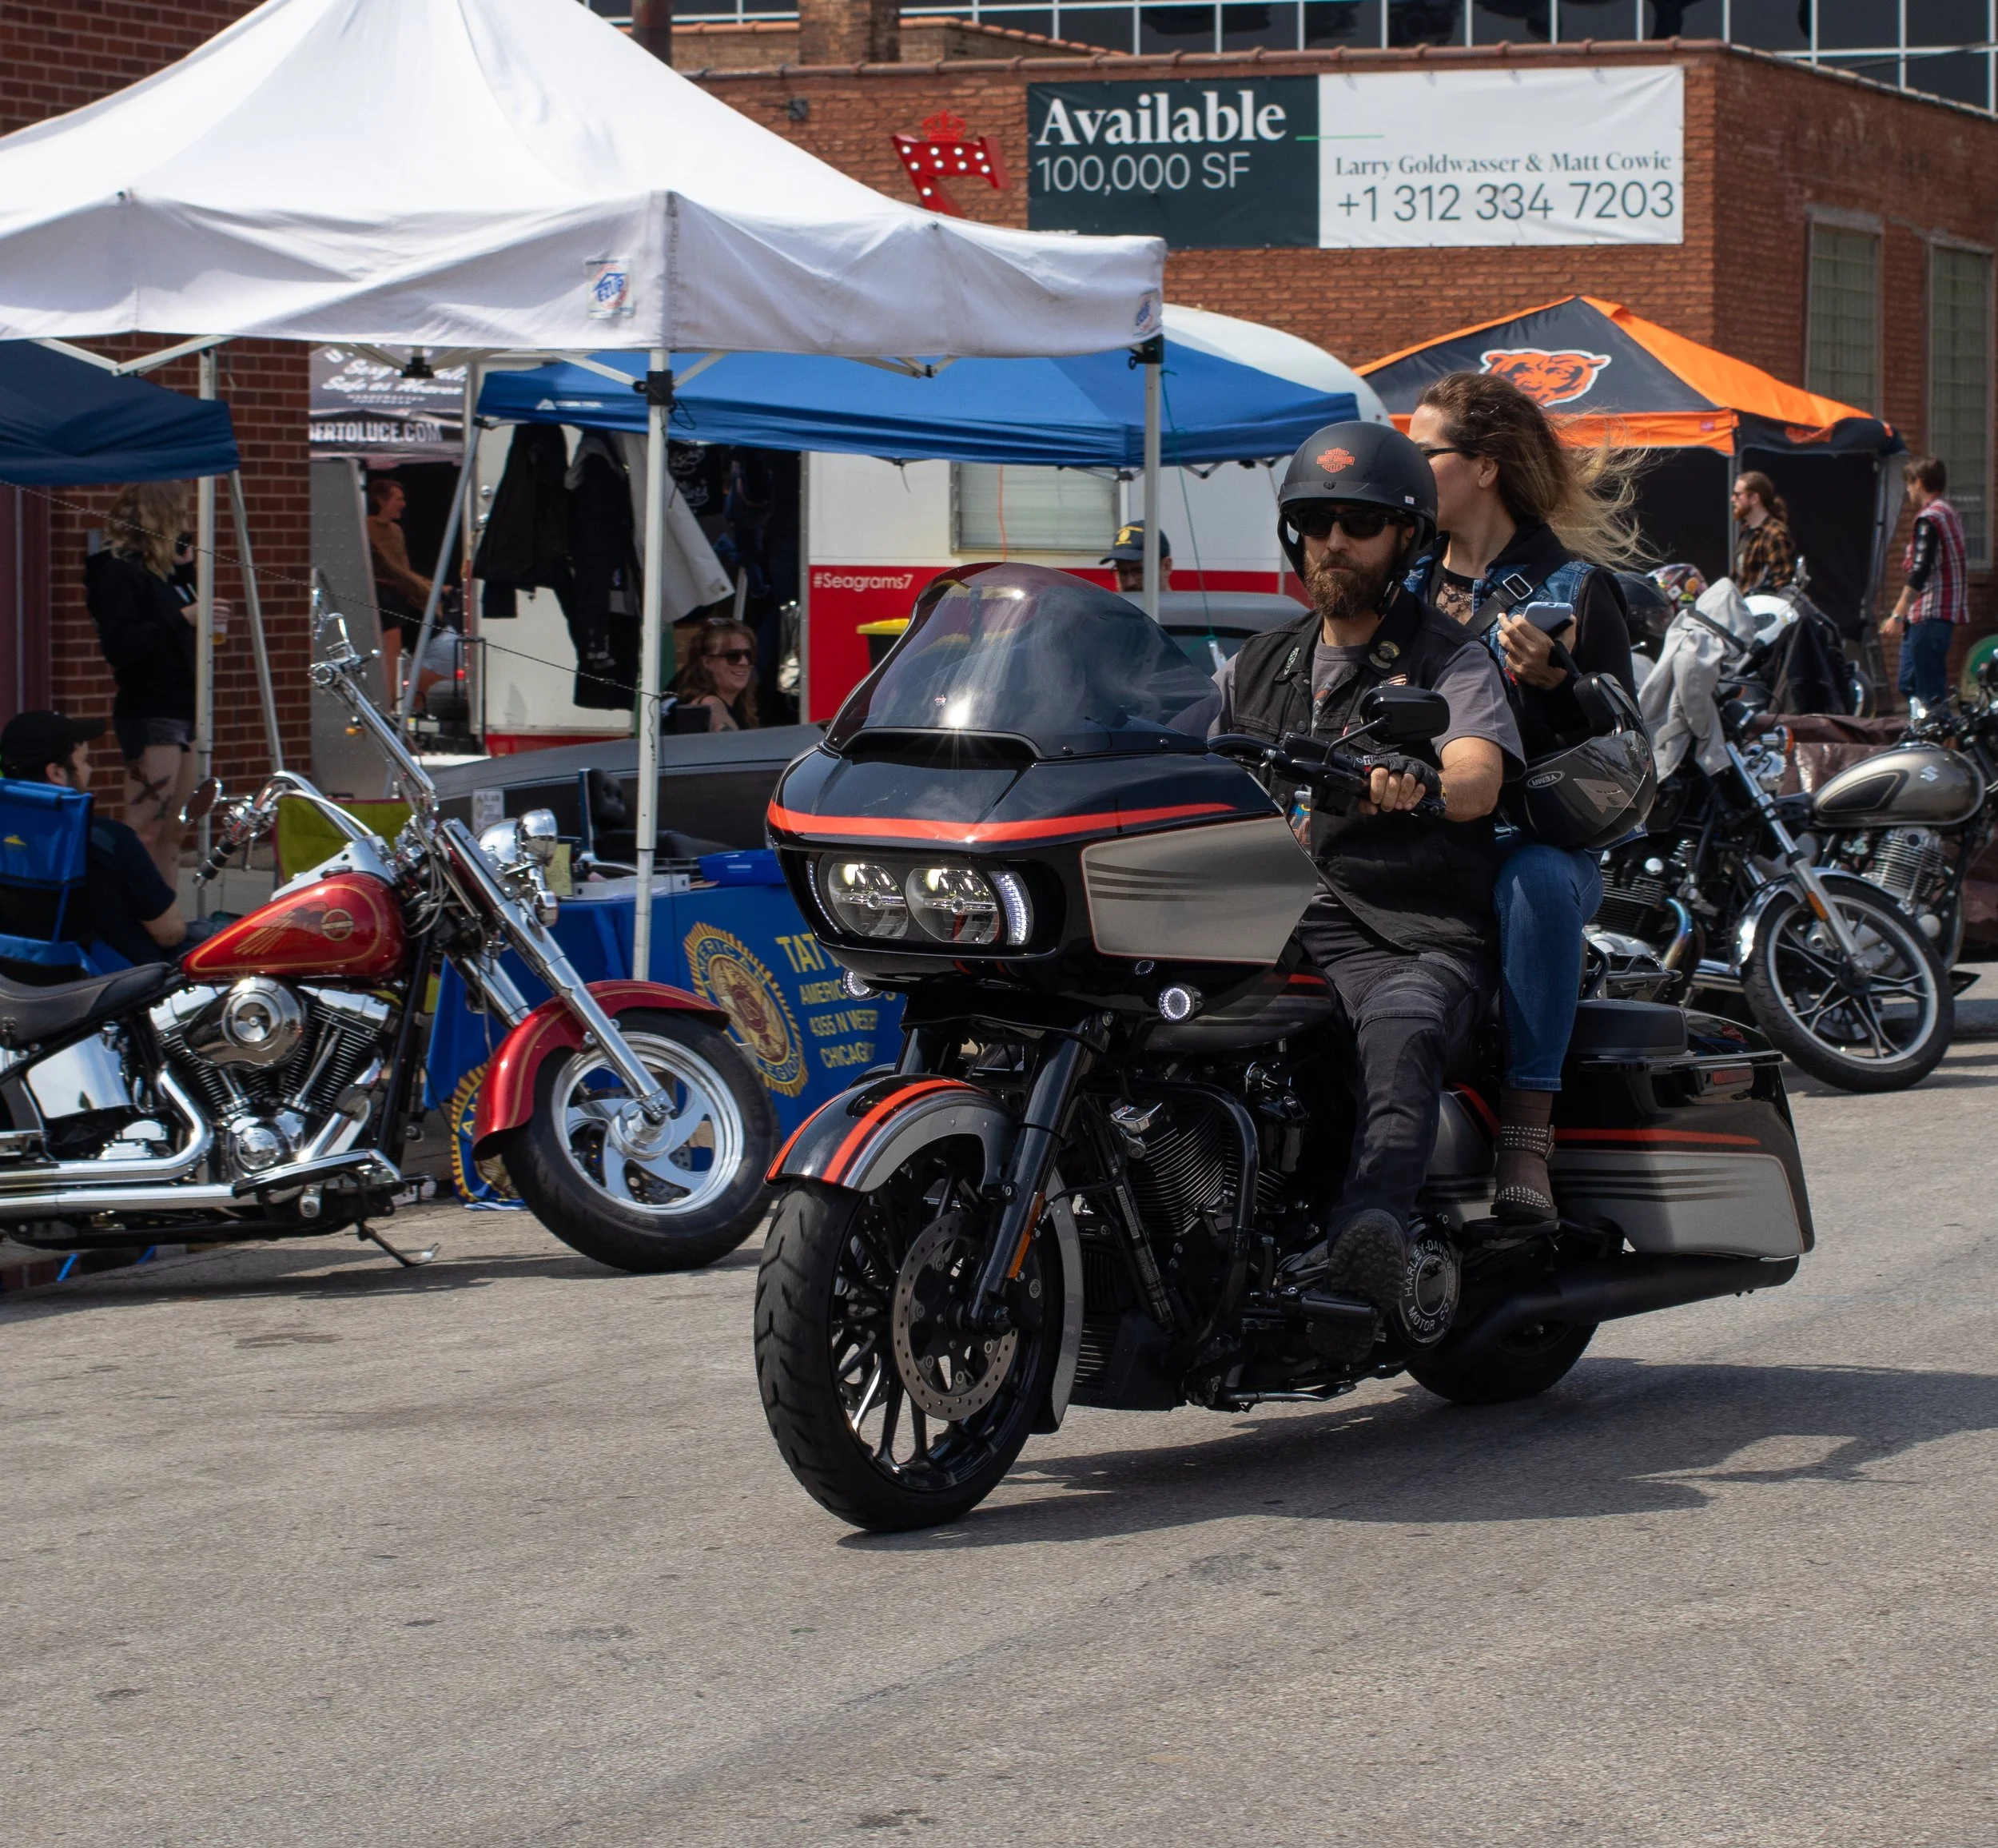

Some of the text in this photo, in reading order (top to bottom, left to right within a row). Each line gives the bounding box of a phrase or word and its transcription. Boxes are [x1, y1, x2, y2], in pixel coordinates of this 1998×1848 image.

[1035, 90, 1288, 145] Available
[1037, 151, 1251, 196] 100,000 SF
[1335, 150, 1672, 180] Larry Goldwasser & Matt Cowie
[1337, 181, 1675, 221] +1 312 334 7203
[814, 572, 913, 592] #Seagrams7
[1407, 1305, 1435, 1332] MOTOR
